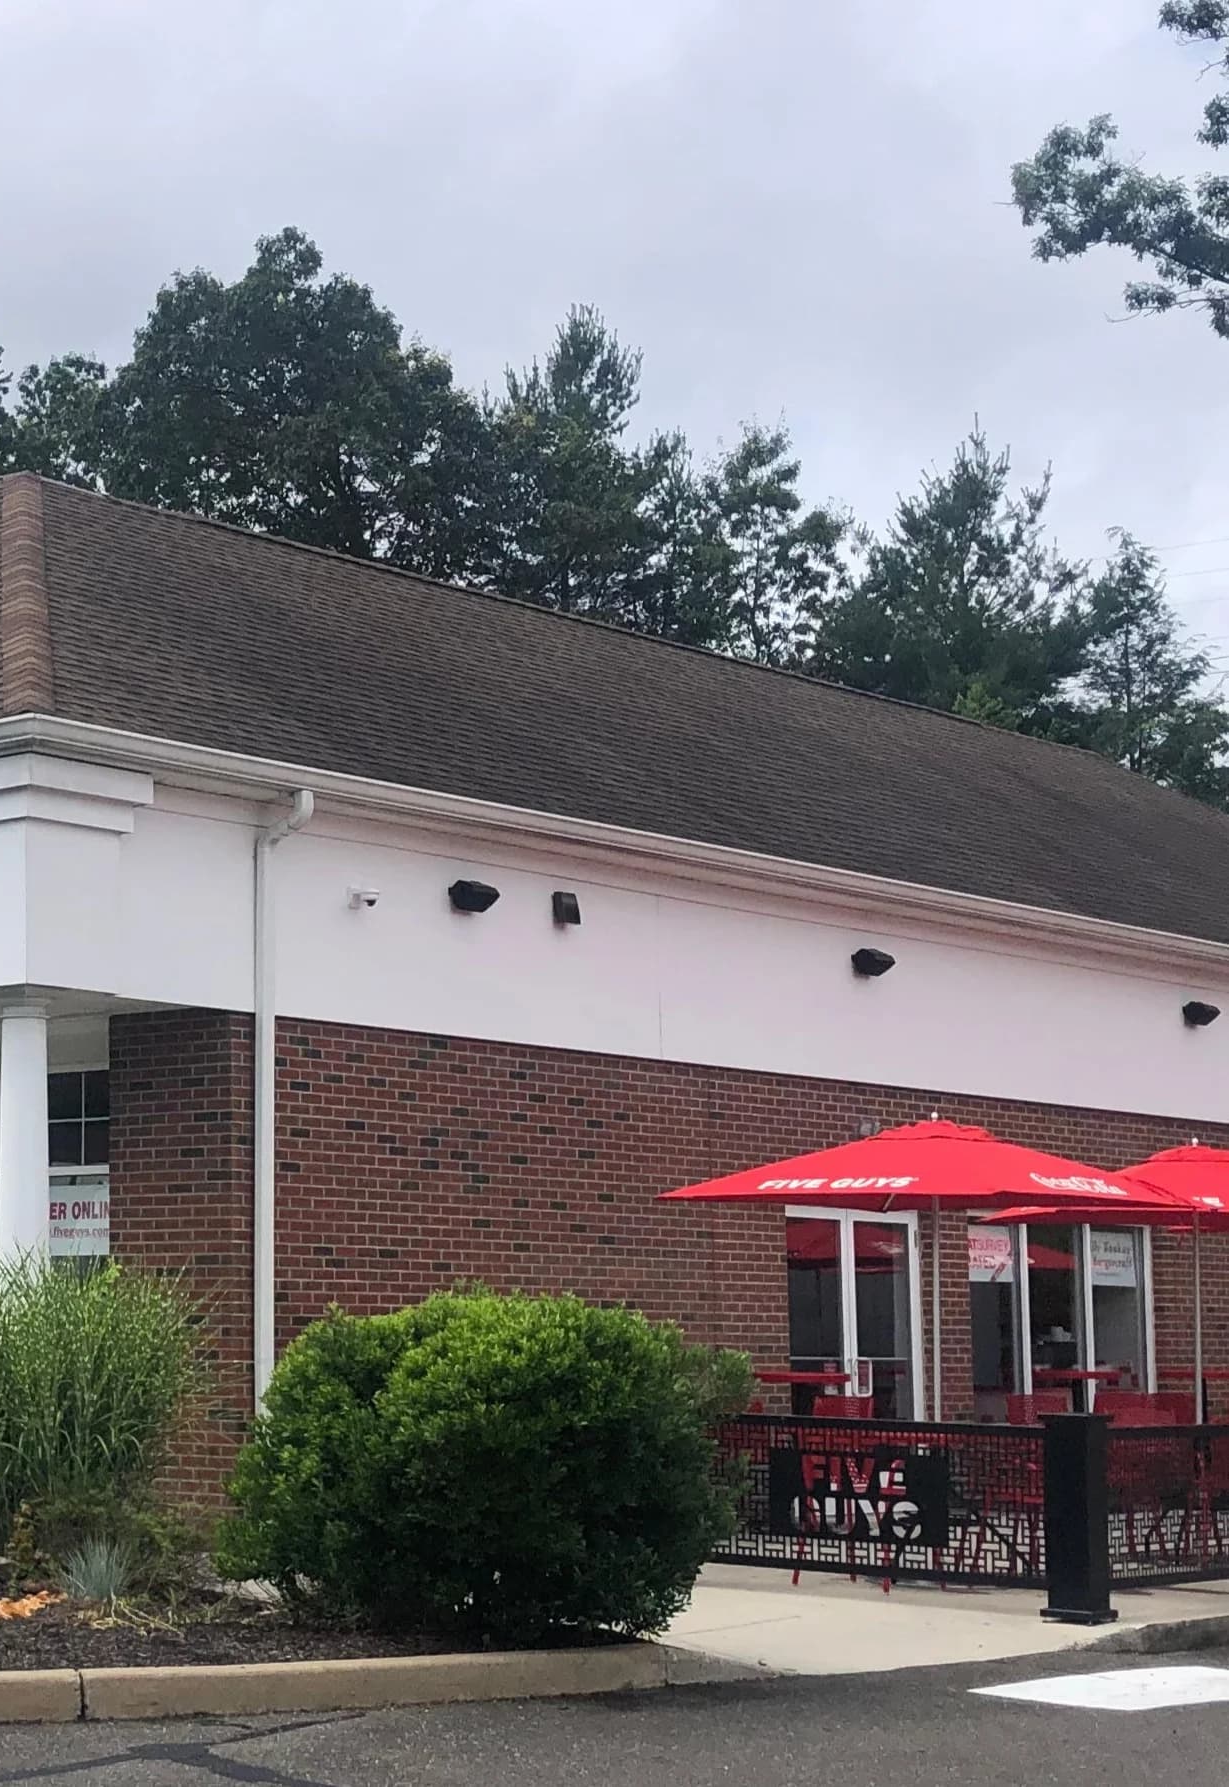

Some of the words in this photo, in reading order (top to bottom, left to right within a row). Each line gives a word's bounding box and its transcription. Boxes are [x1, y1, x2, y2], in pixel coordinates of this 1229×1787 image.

[757, 1178, 828, 1190] FIVE
[830, 1177, 914, 1188] GUYS
[72, 1201, 109, 1219] ONLIN
[801, 1454, 907, 1495] FIVE
[790, 1496, 921, 1539] GUYS
